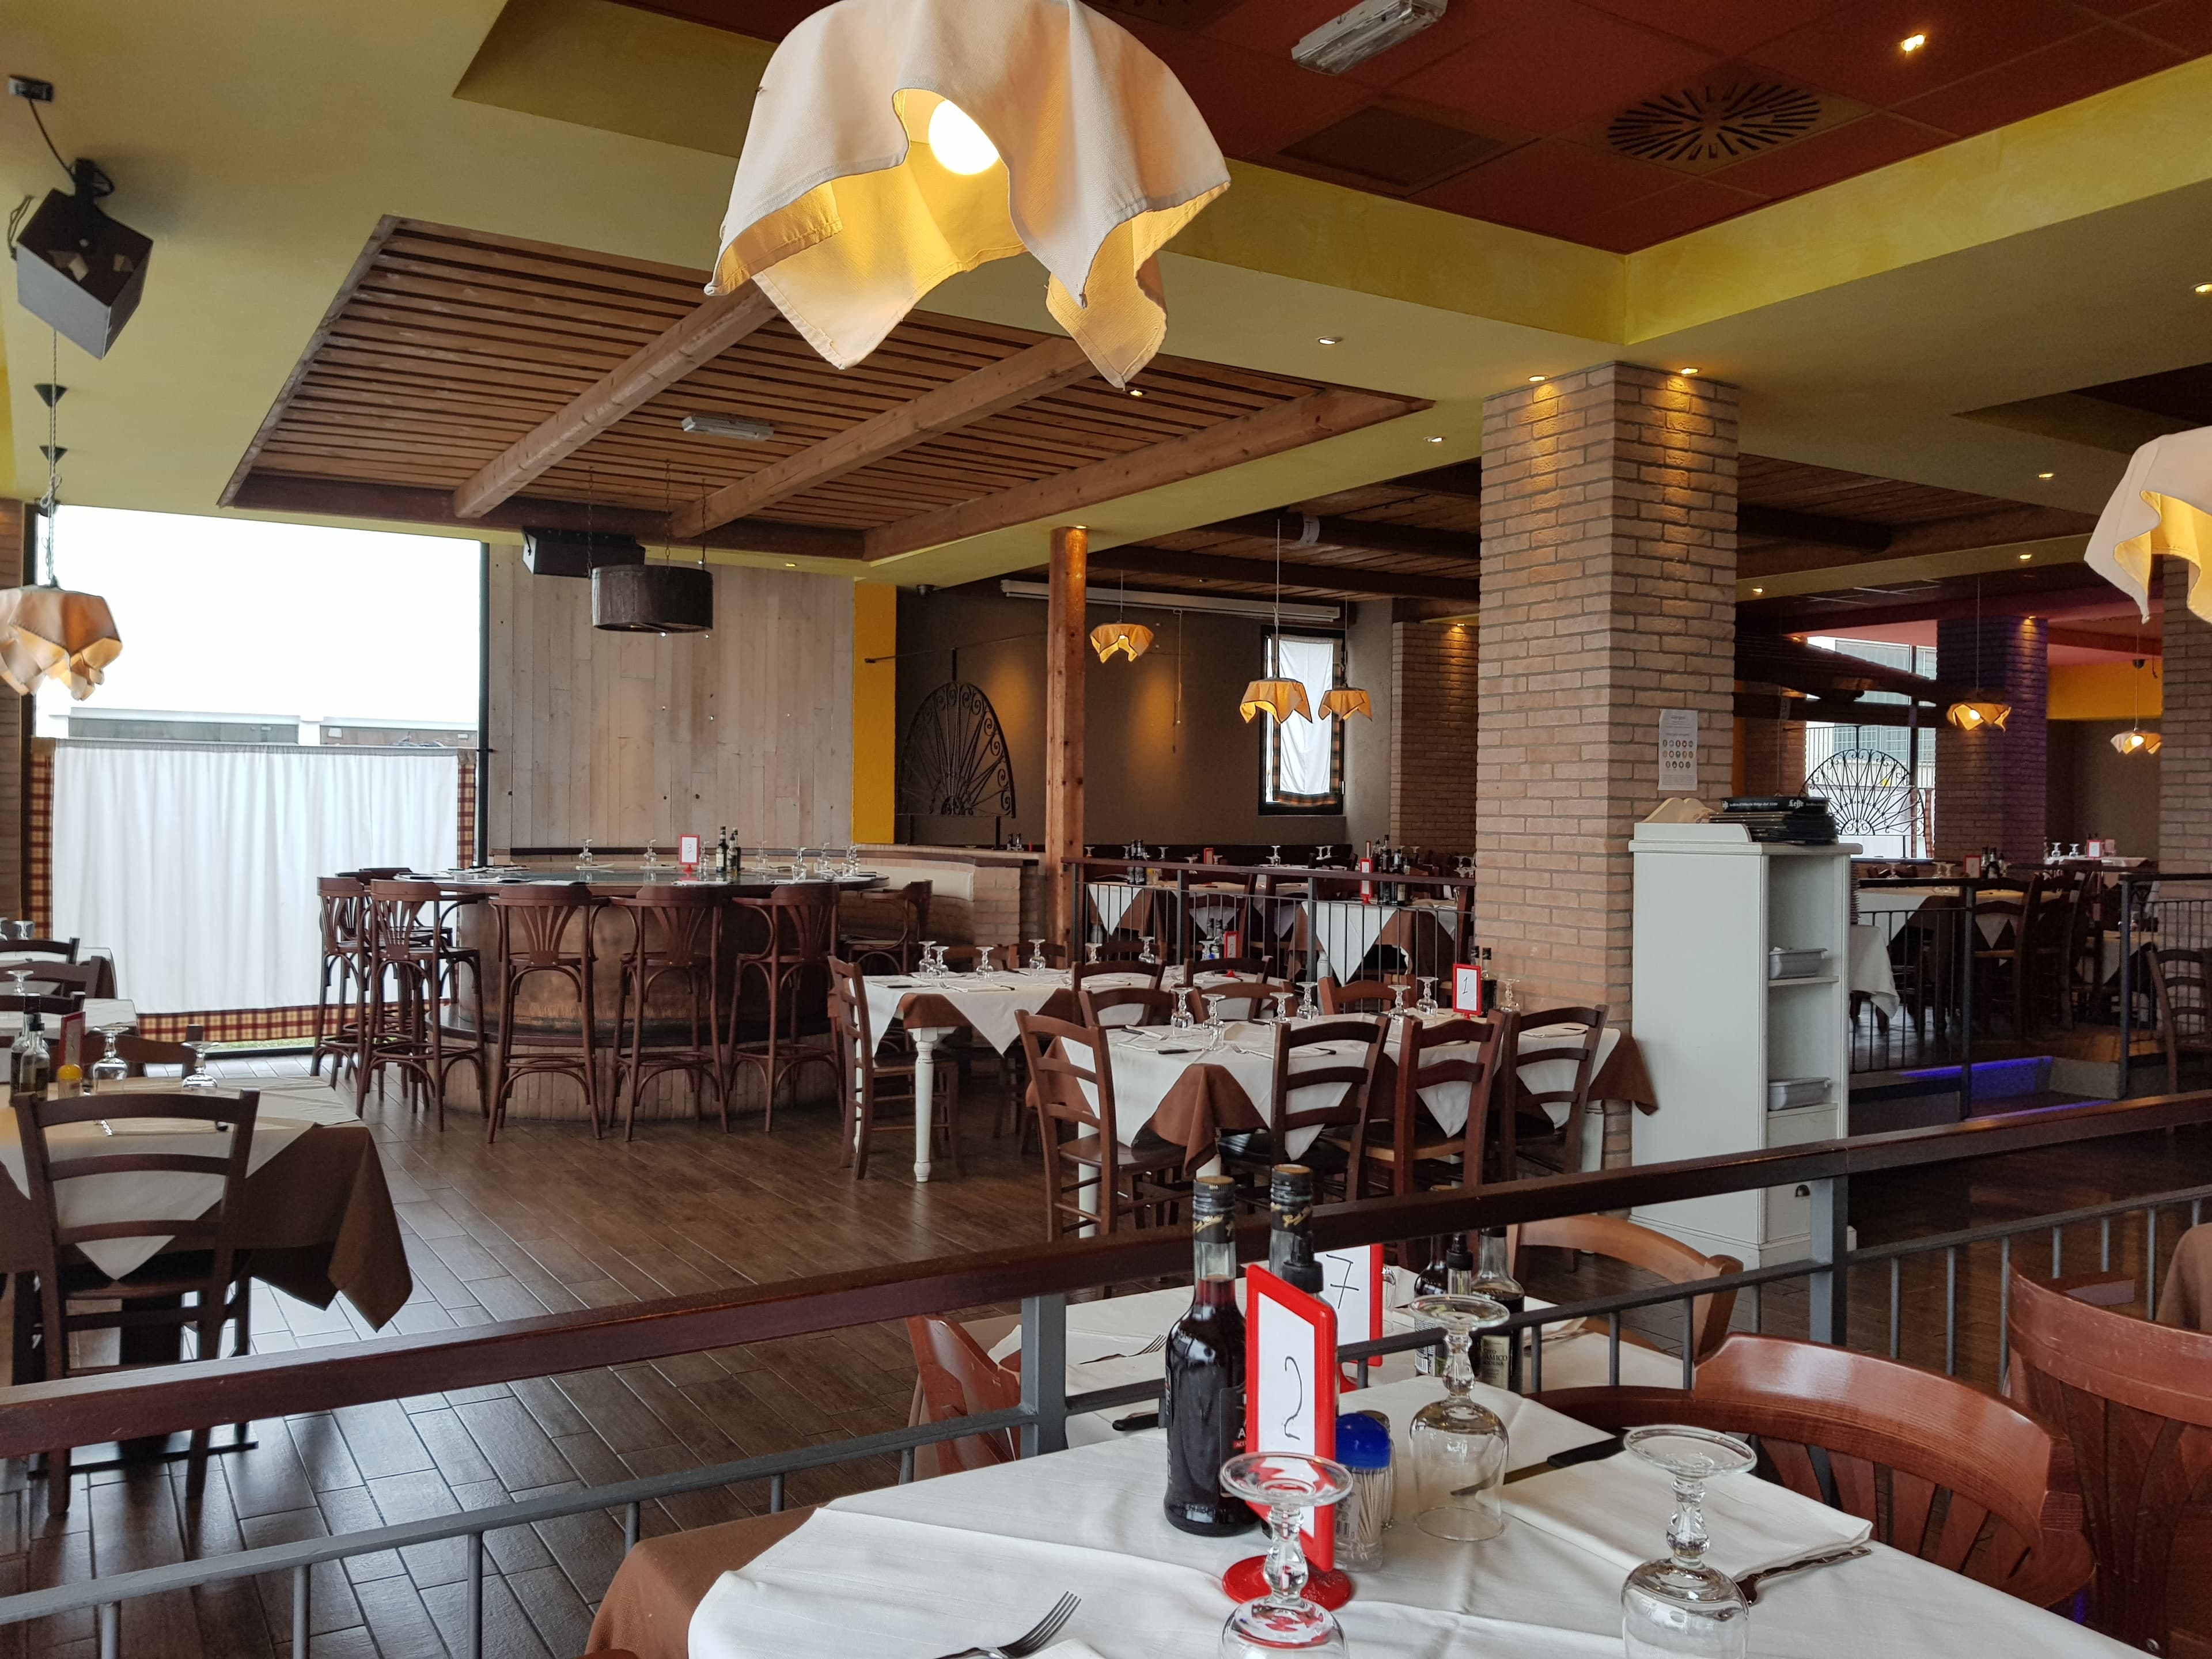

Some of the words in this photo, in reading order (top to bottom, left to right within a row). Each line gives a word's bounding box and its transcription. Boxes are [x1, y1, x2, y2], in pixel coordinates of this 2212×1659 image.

[1788, 799, 1804, 809] Leffe
[1463, 977, 1468, 994] 1
[1325, 1253, 1359, 1309] 7
[1283, 1356, 1302, 1440] 2
